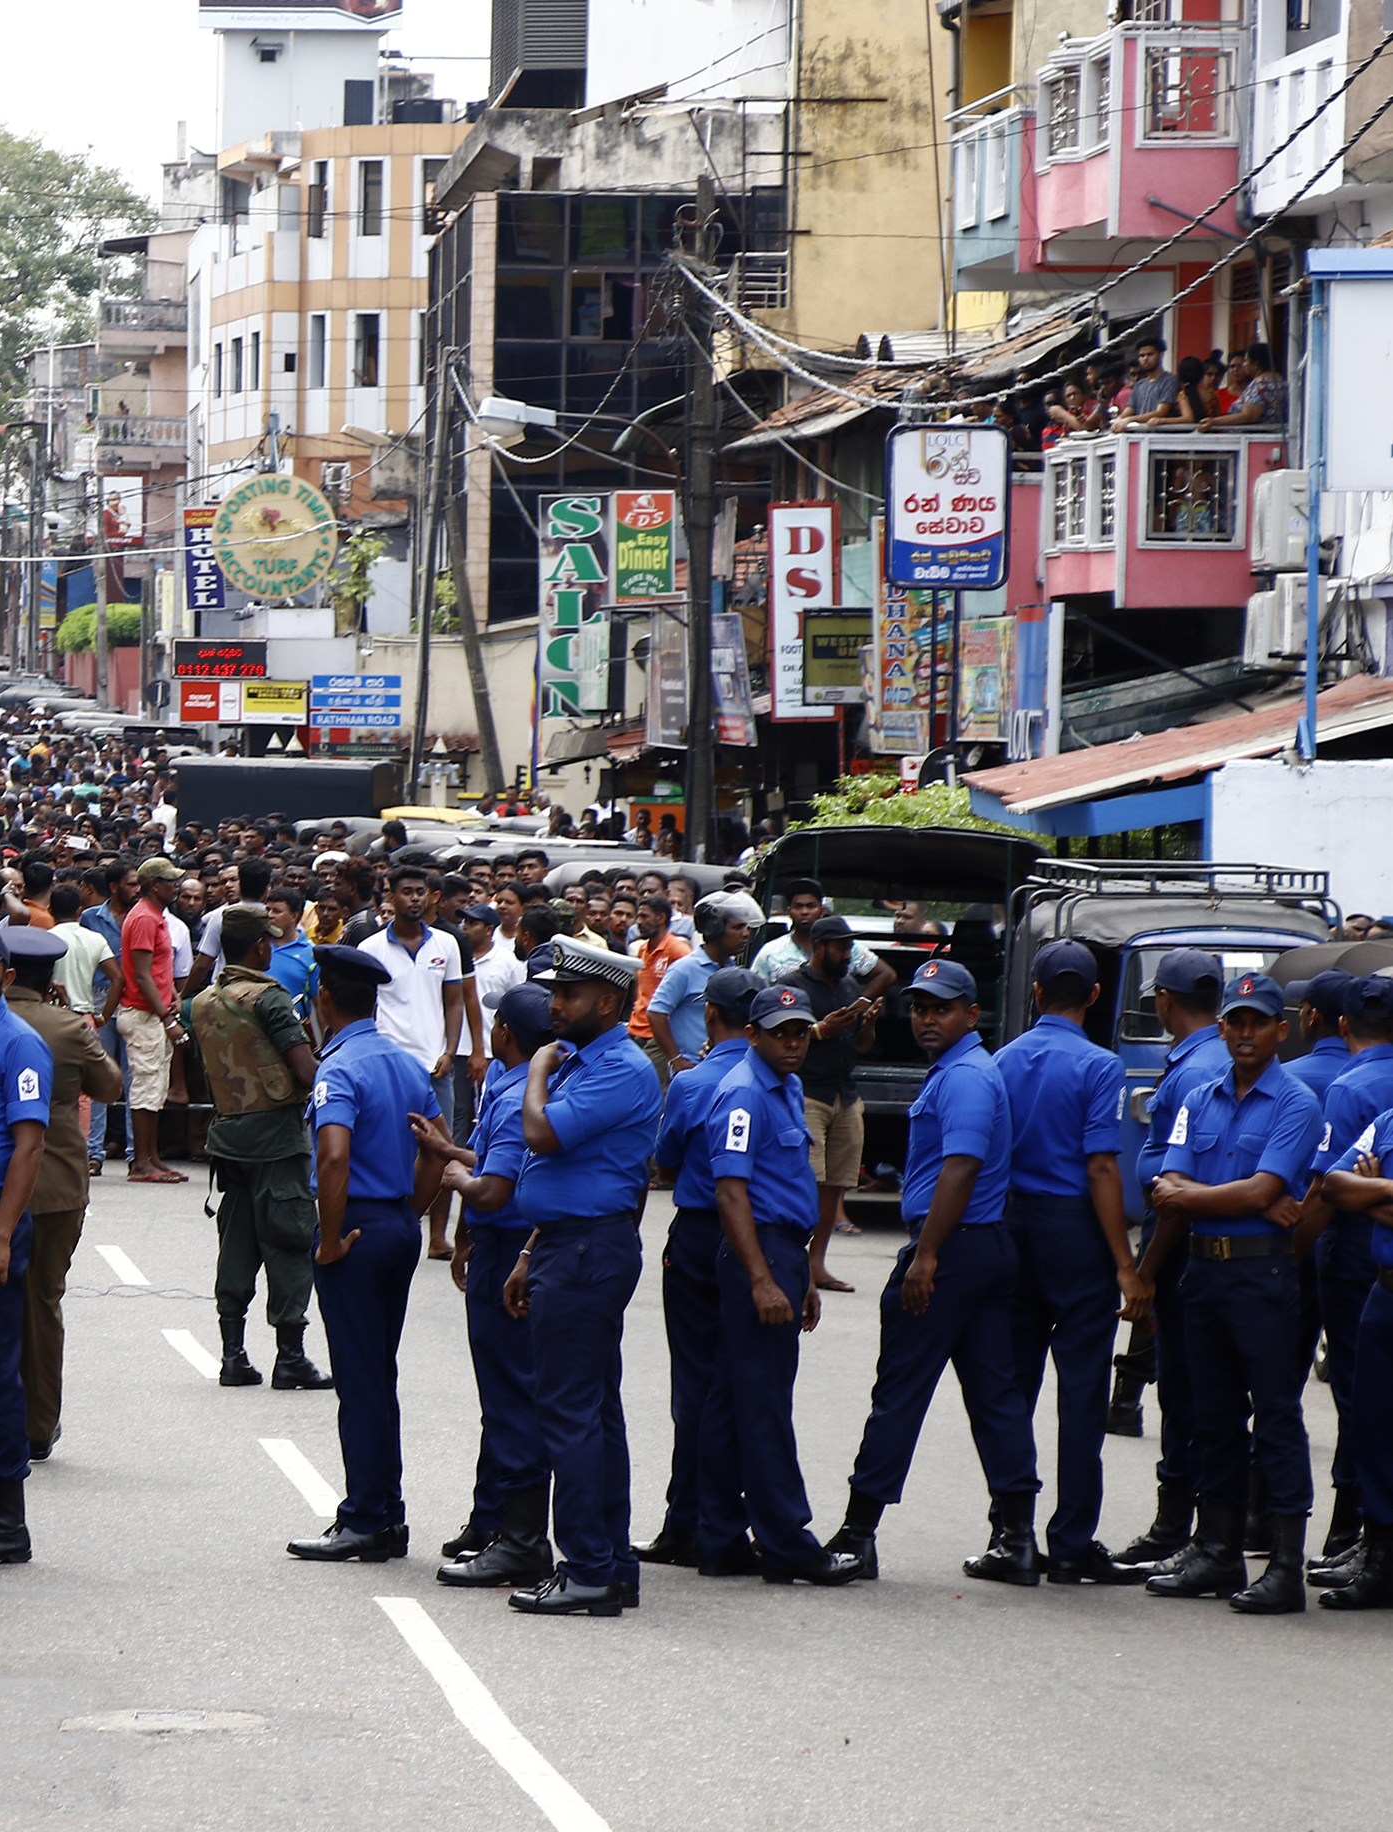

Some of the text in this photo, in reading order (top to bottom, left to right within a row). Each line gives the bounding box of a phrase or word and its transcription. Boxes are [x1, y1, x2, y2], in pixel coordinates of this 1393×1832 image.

[927, 434, 965, 447] LOLC
[216, 478, 333, 535] SPORTING TIMES
[904, 493, 940, 513] රන්
[624, 511, 665, 527] EDS
[916, 516, 986, 535] සේවාව
[637, 533, 668, 548] Easy
[618, 541, 669, 570] Dinner
[189, 527, 219, 607] HOTEL
[219, 548, 330, 596] ACCOUNTANTS
[253, 558, 298, 574] TURF
[884, 686, 912, 703] HD
[317, 715, 396, 725] RATHNAM ROAD
